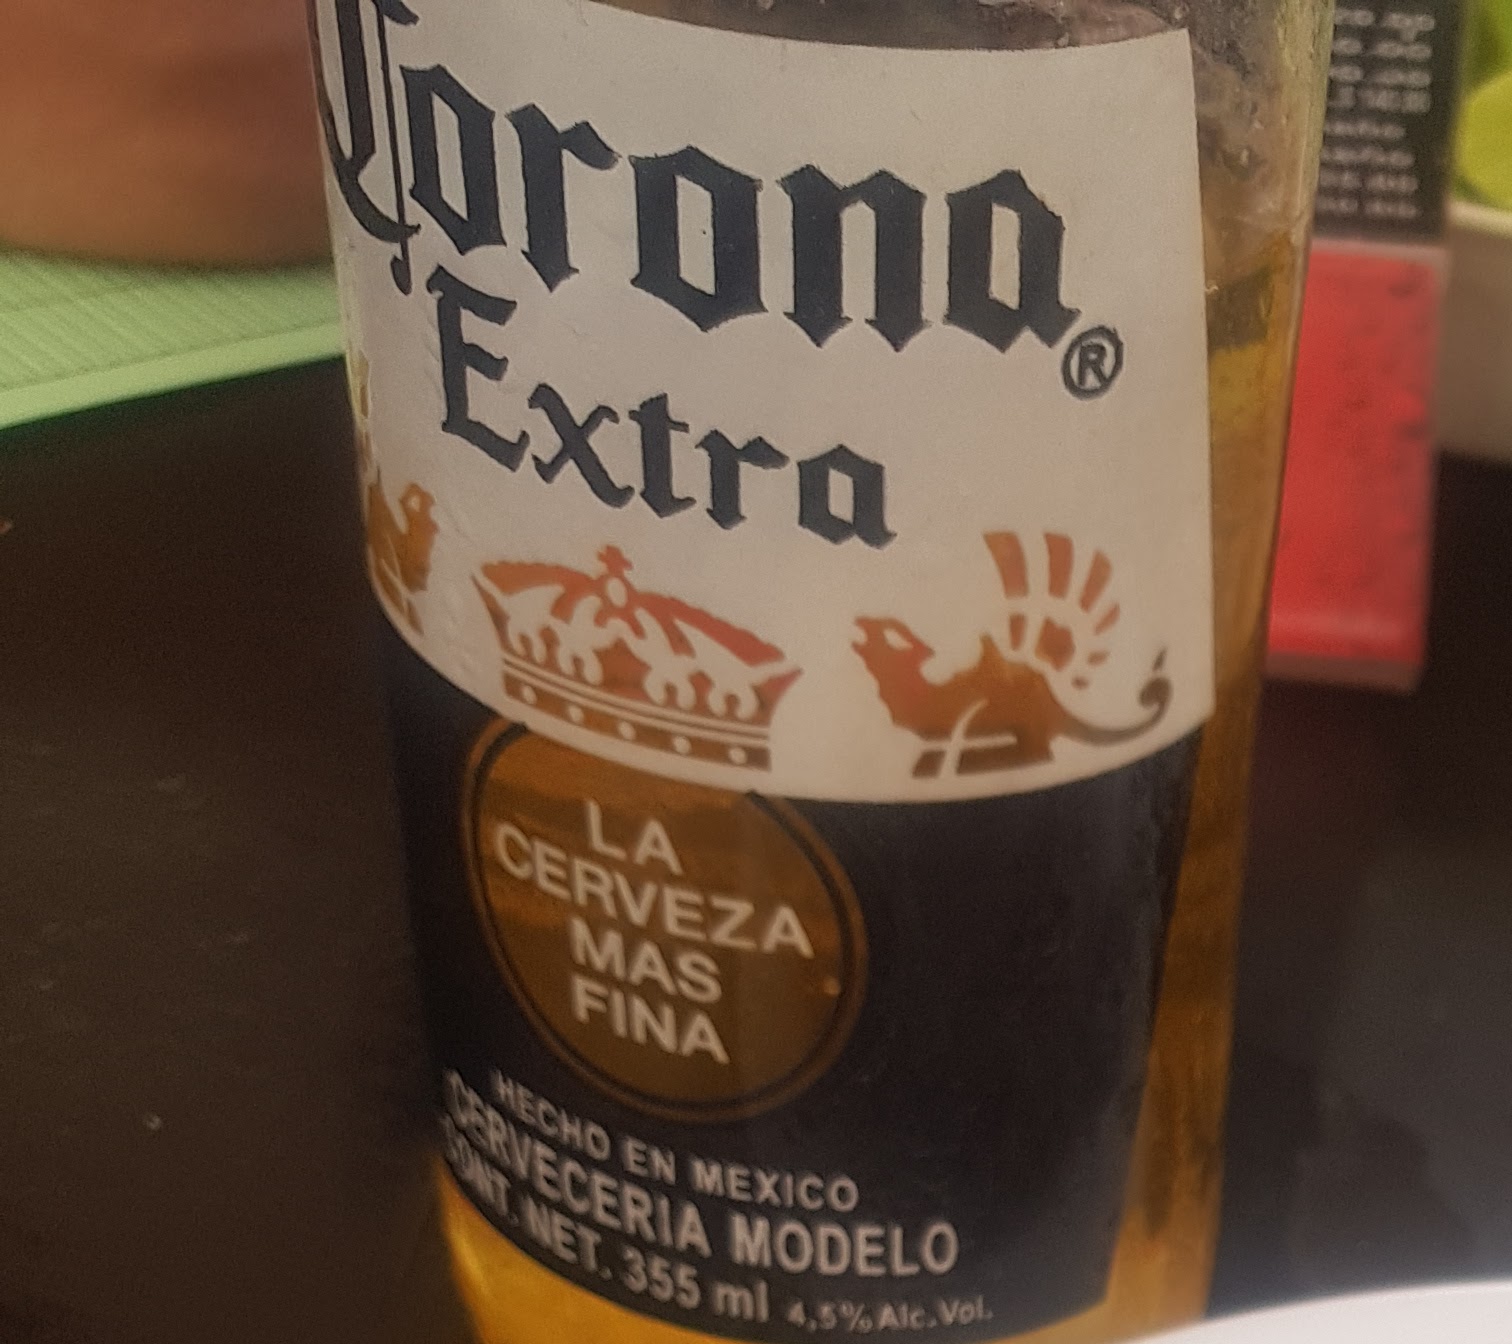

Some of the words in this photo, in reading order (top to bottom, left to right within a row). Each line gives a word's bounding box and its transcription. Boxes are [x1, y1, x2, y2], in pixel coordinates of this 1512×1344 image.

[305, 0, 1082, 353] Corona
[427, 264, 897, 549] Extra
[495, 821, 815, 960] CERVEZA
[587, 800, 683, 876] LA
[570, 914, 722, 1005] MAS
[570, 974, 730, 1065] FINA
[445, 1067, 713, 1259] CERVECERIA
[729, 1211, 959, 1277] MODELO
[490, 1069, 611, 1162] HECHO
[620, 1135, 677, 1186] EN
[690, 1156, 859, 1213] MEXICO
[518, 1194, 614, 1282] NET.
[621, 1245, 701, 1309] 355
[711, 1278, 769, 1323] ml
